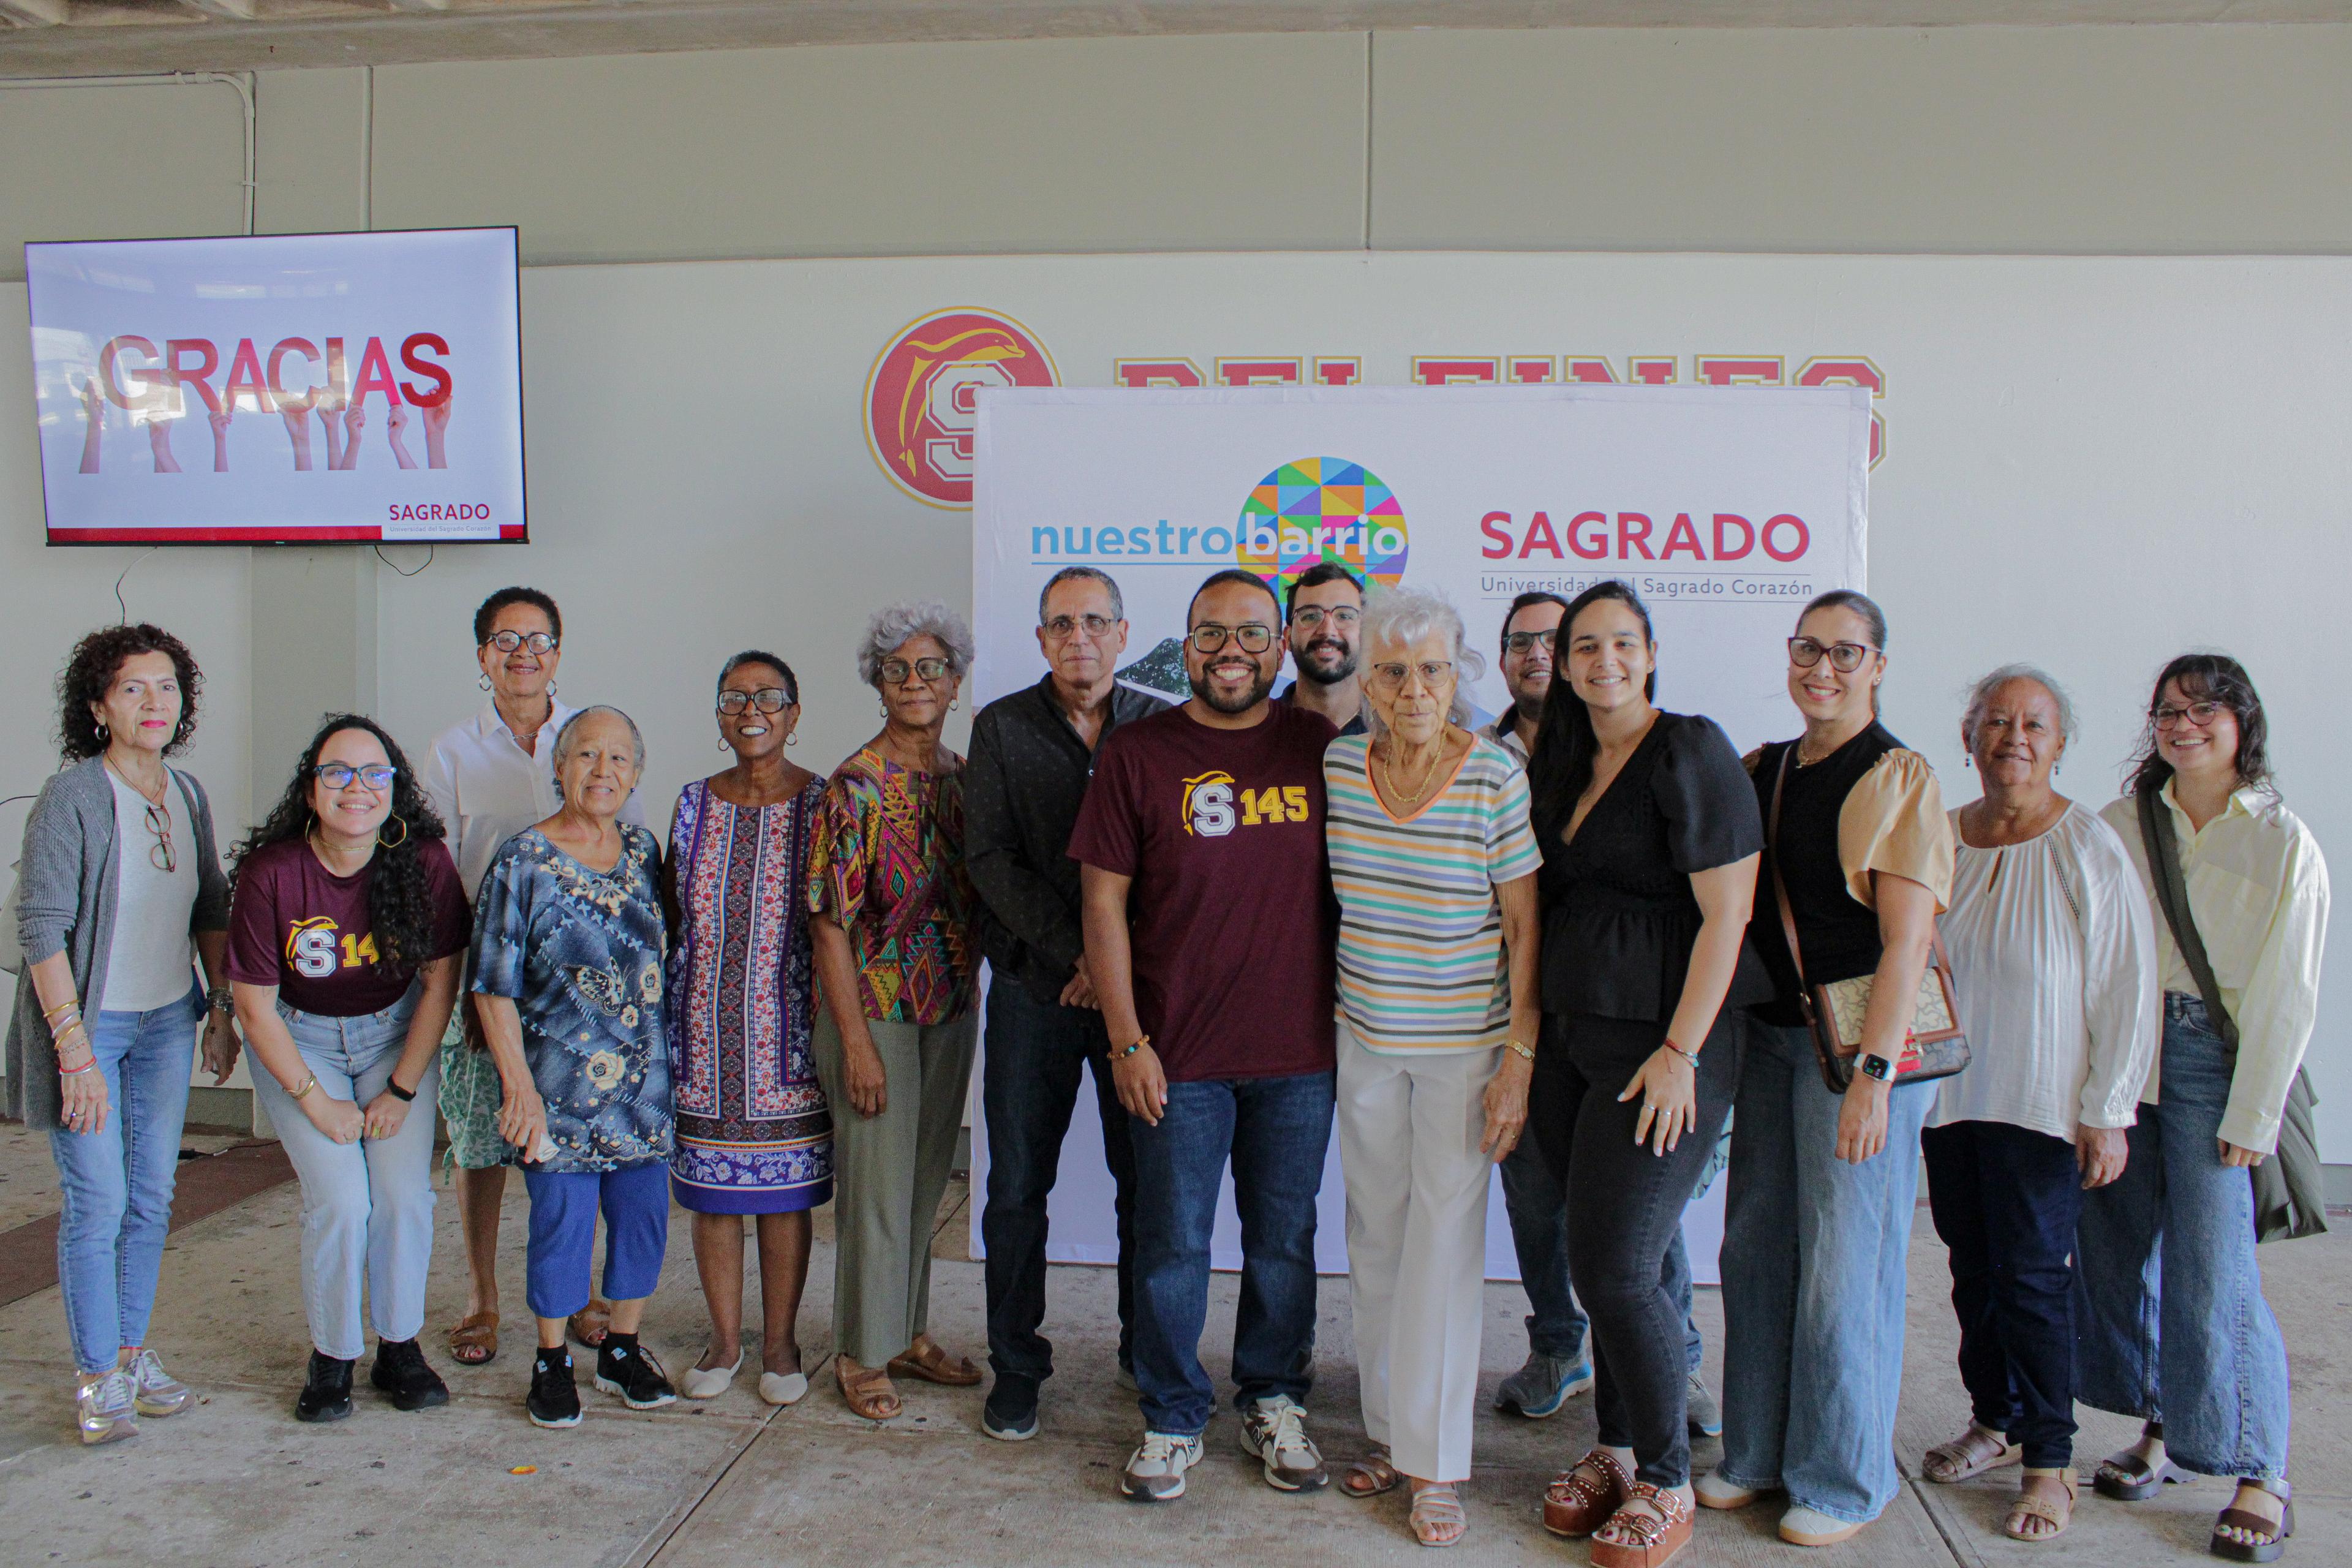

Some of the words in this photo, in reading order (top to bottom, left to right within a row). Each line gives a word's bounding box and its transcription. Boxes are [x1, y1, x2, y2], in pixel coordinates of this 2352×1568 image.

[99, 332, 452, 413] GRACIAS
[389, 503, 490, 521] SAGRADO
[1031, 519, 1233, 554] nuestro
[1245, 511, 1405, 555] barrio
[1480, 510, 1811, 562] SAGRADO
[1643, 578, 1724, 597] Sagrado
[1732, 579, 1812, 595] Corazón
[1191, 783, 1236, 837] S
[1240, 786, 1309, 826] 145
[295, 929, 337, 978] S
[341, 931, 381, 968] 14
